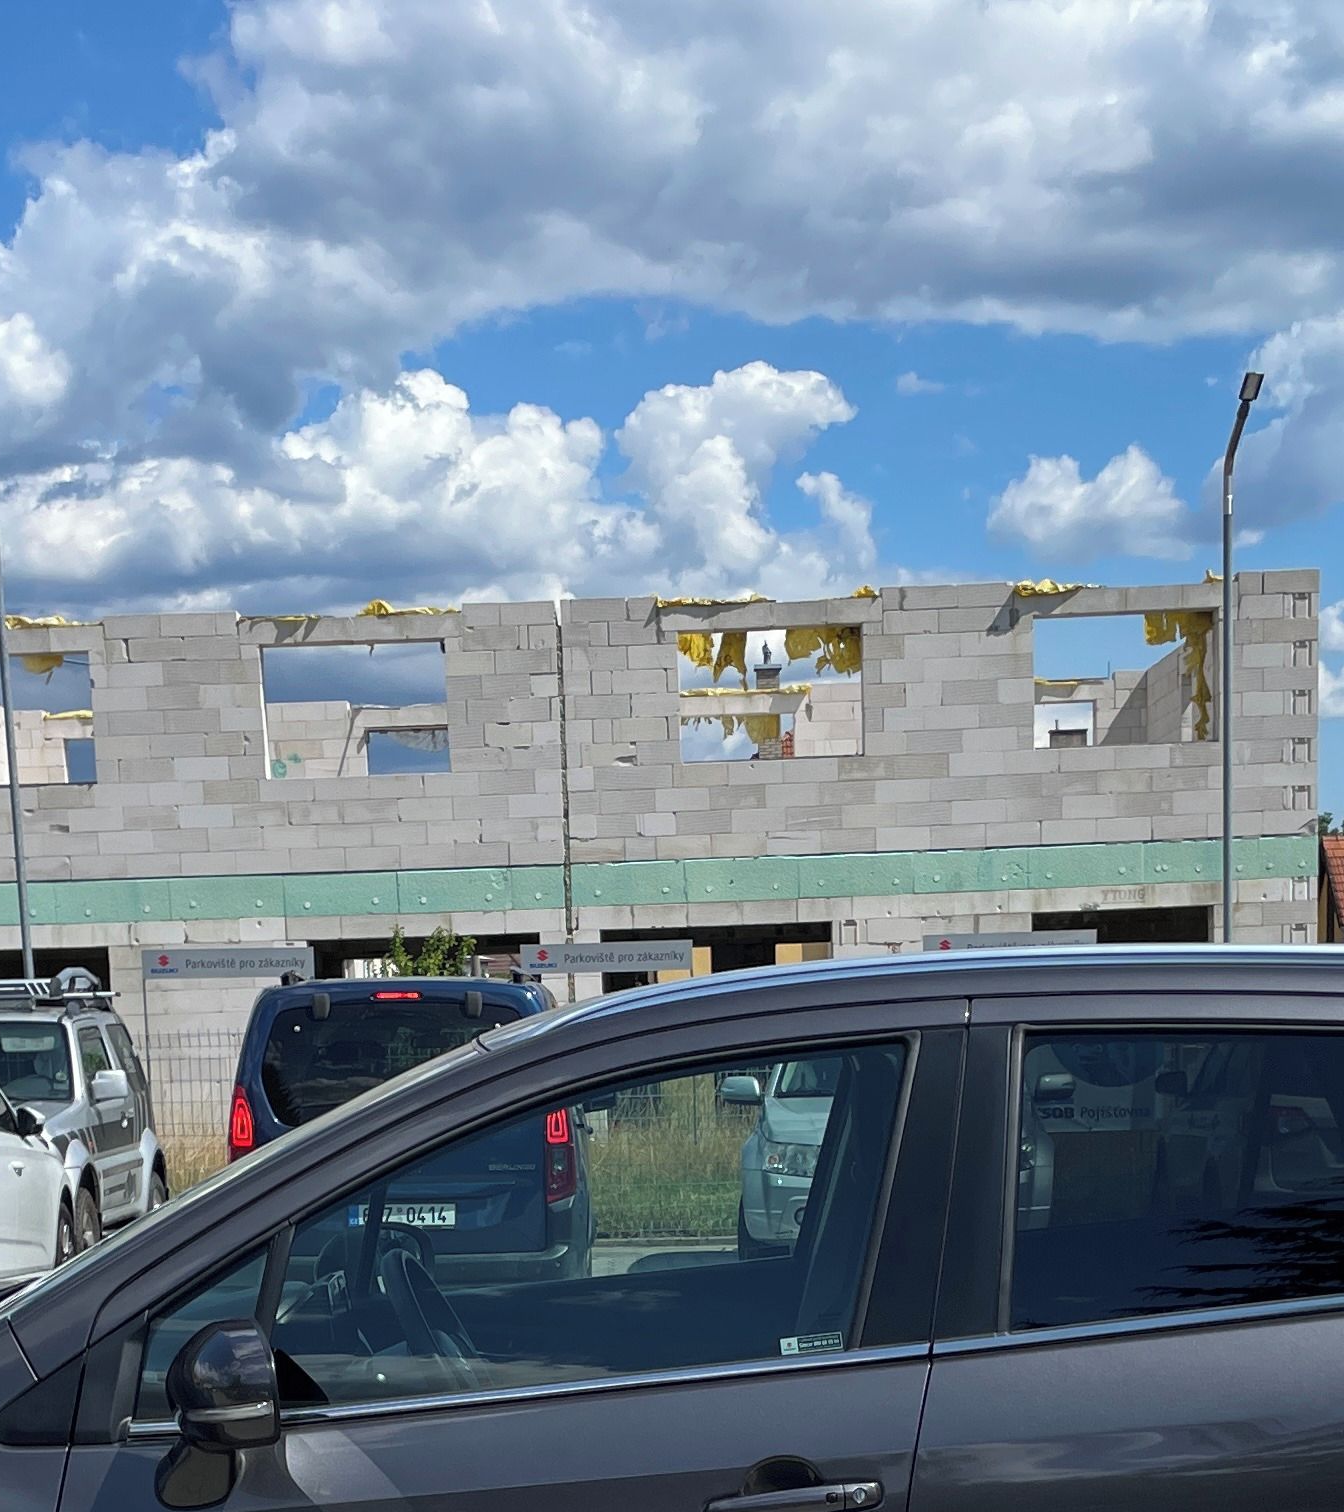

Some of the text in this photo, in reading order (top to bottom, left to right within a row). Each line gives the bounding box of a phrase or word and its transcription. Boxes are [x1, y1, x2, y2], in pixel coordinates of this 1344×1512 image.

[564, 951, 684, 963] Parkoviště pro zákazníky
[185, 958, 305, 970] Parkoviště pro zákazníky
[406, 1206, 447, 1223] 0414
